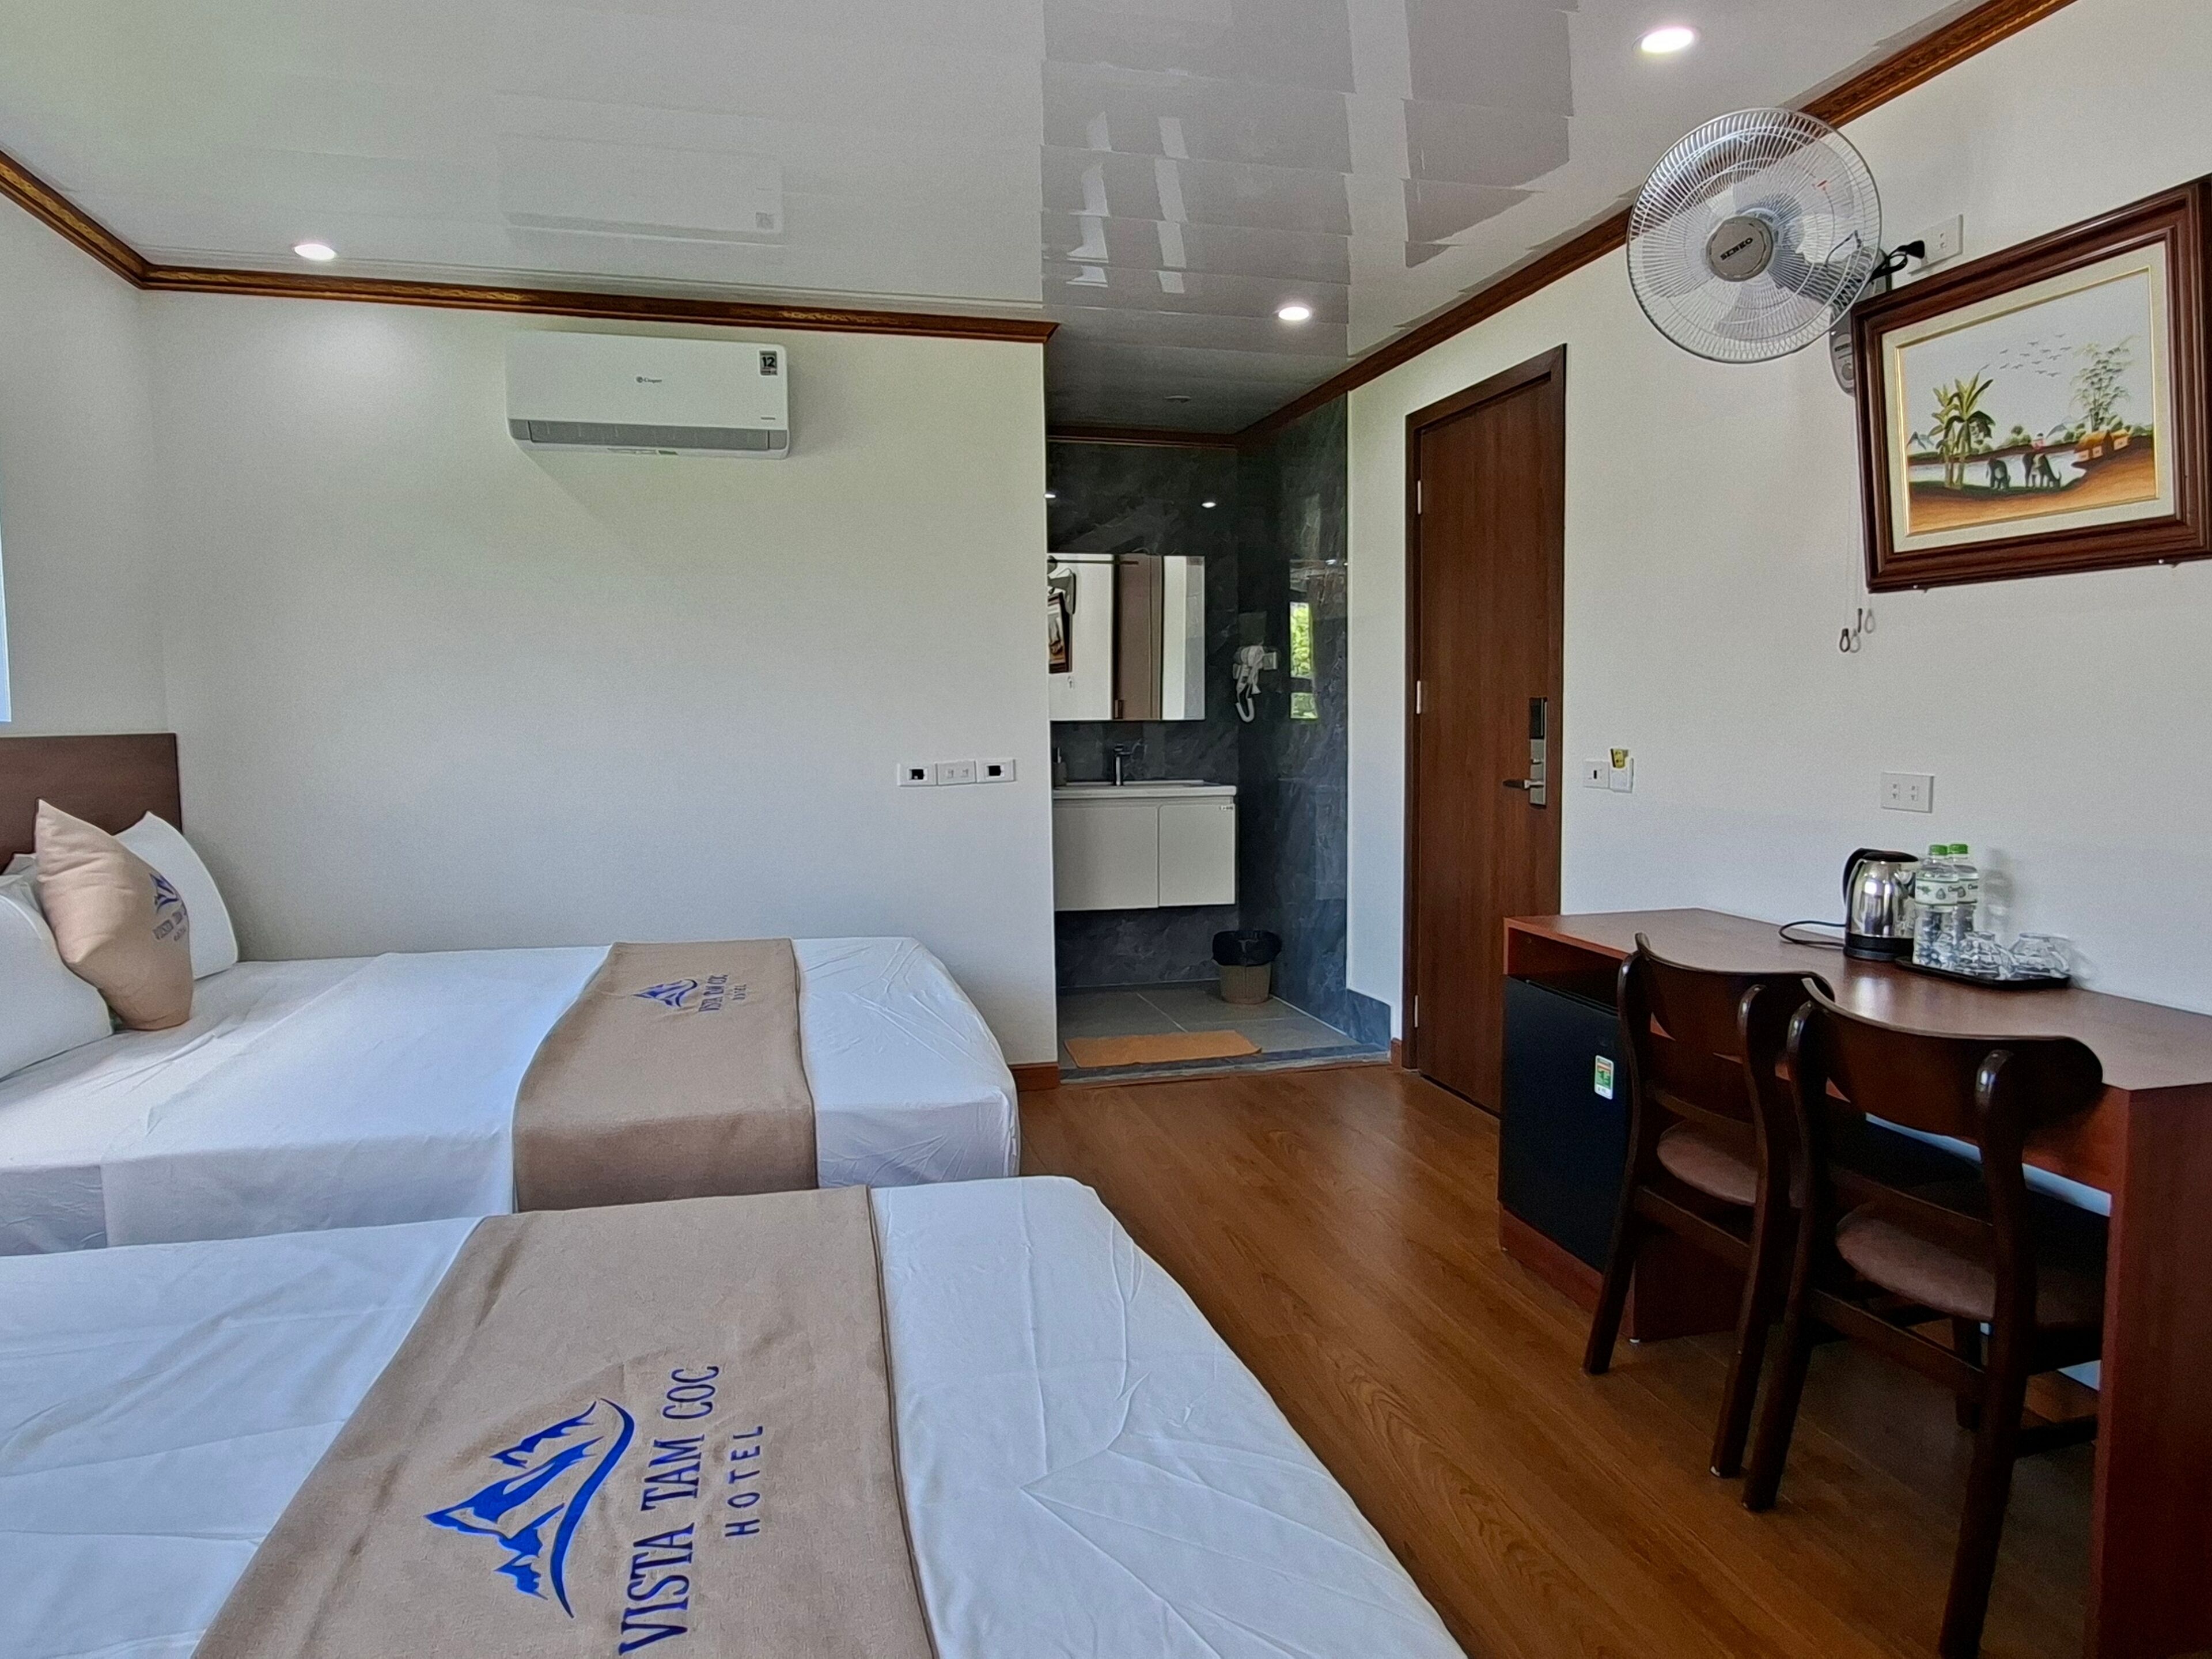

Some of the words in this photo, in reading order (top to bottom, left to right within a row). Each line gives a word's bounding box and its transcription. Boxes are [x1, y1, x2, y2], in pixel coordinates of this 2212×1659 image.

[762, 356, 775, 368] 12
[662, 1366, 719, 1419] COC
[640, 1433, 705, 1512] TAM
[725, 1426, 763, 1537] HOTEL
[618, 1522, 695, 1656] VISTA
